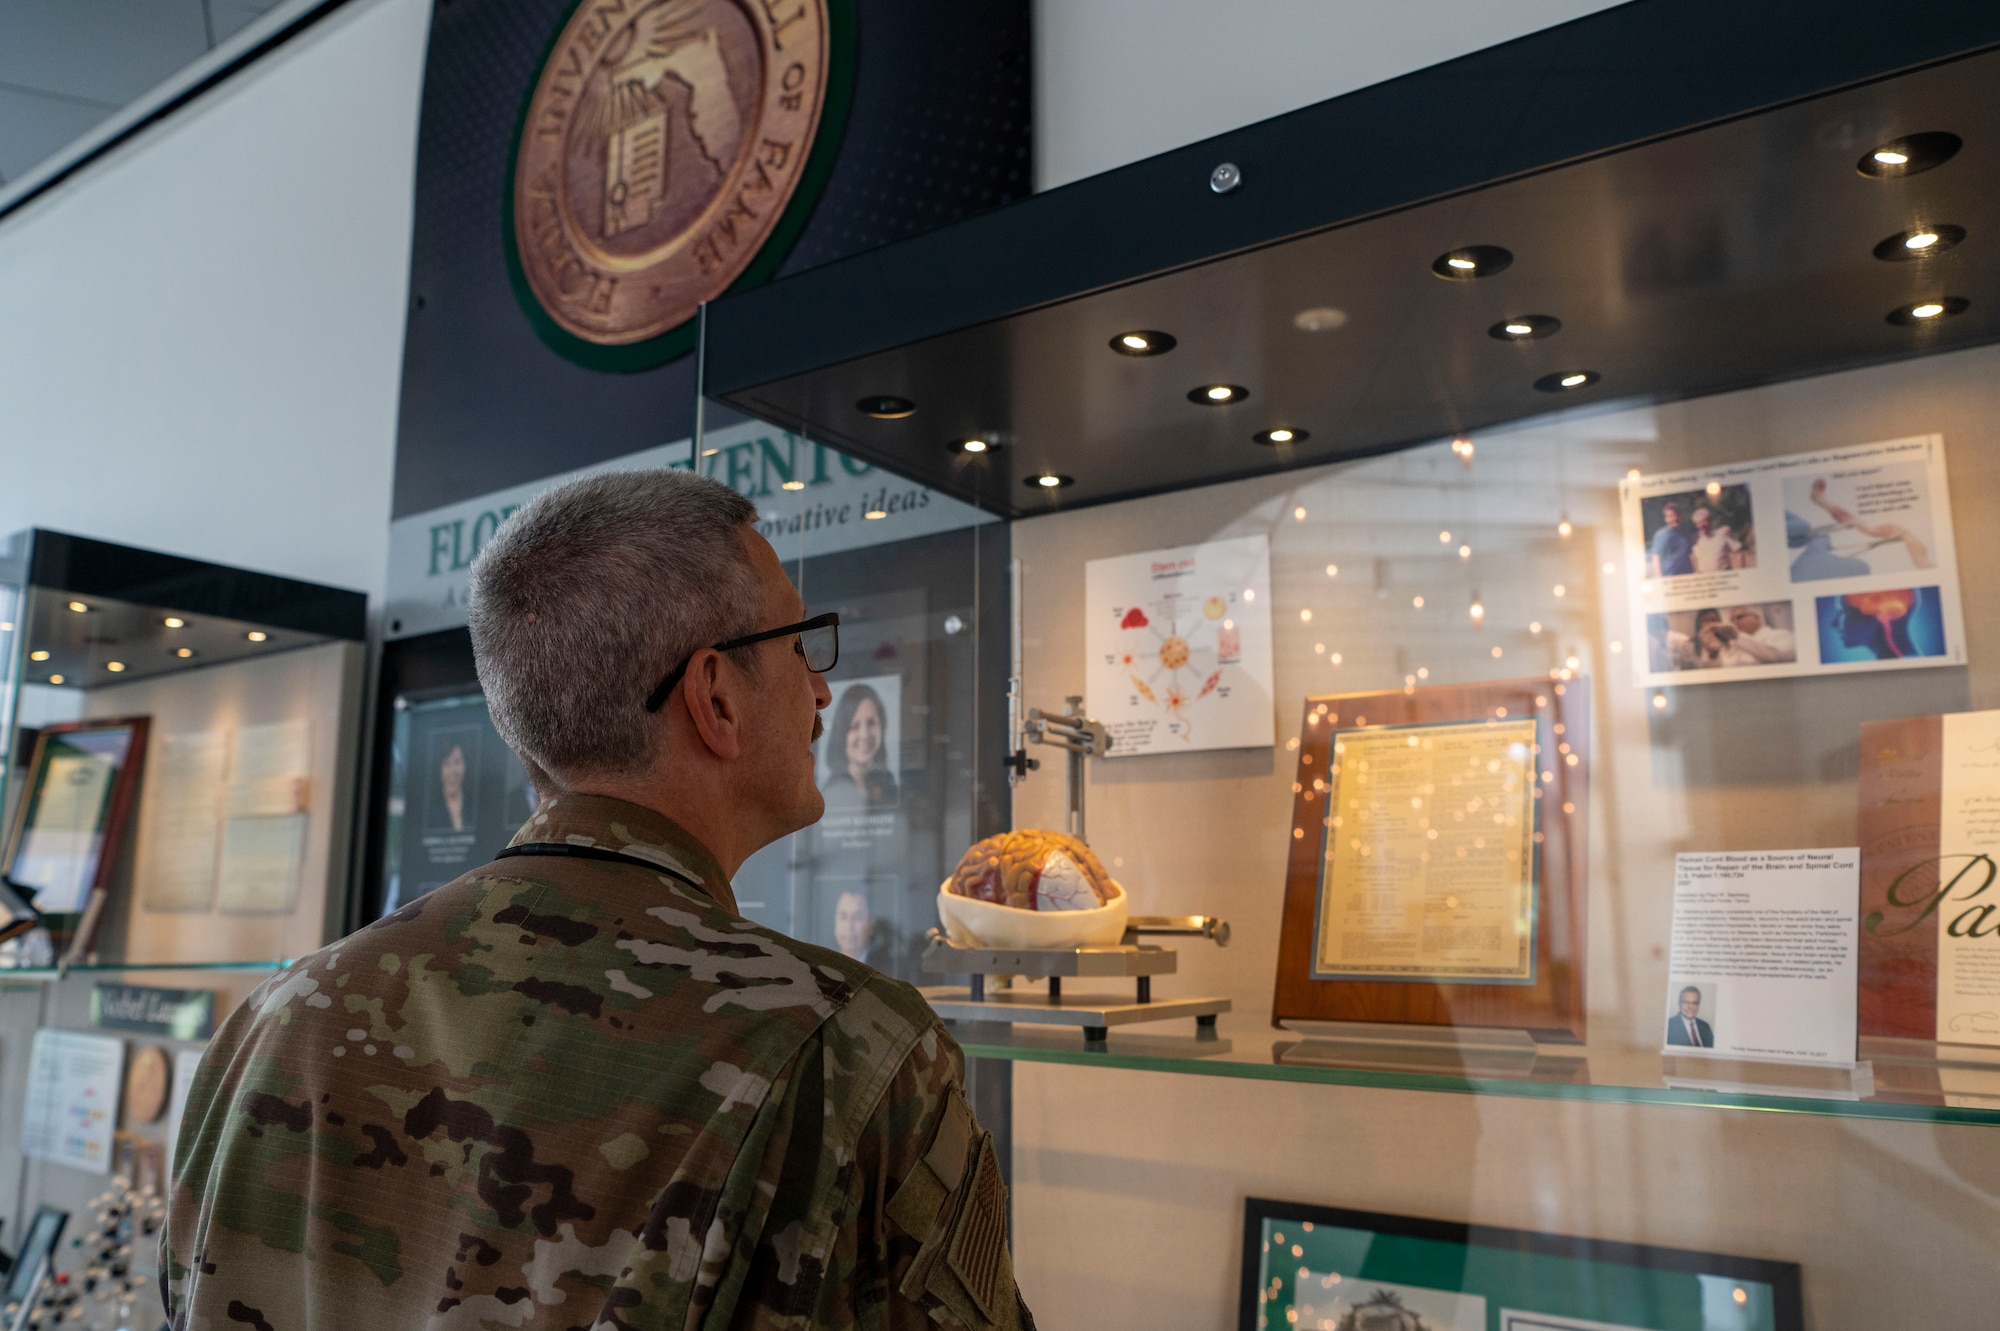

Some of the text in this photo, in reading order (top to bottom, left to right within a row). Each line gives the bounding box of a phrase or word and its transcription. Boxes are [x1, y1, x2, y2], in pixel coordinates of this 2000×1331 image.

[691, 138, 793, 275] FAME
[861, 486, 930, 520] ideas
[1716, 864, 1740, 872] Repair
[1788, 862, 1804, 870] and
[1806, 862, 1832, 871] Spinal
[1726, 854, 1748, 862] Blood
[1767, 854, 1795, 862] Source
[1807, 853, 1834, 861] Neural
[1865, 853, 2000, 939] Pa
